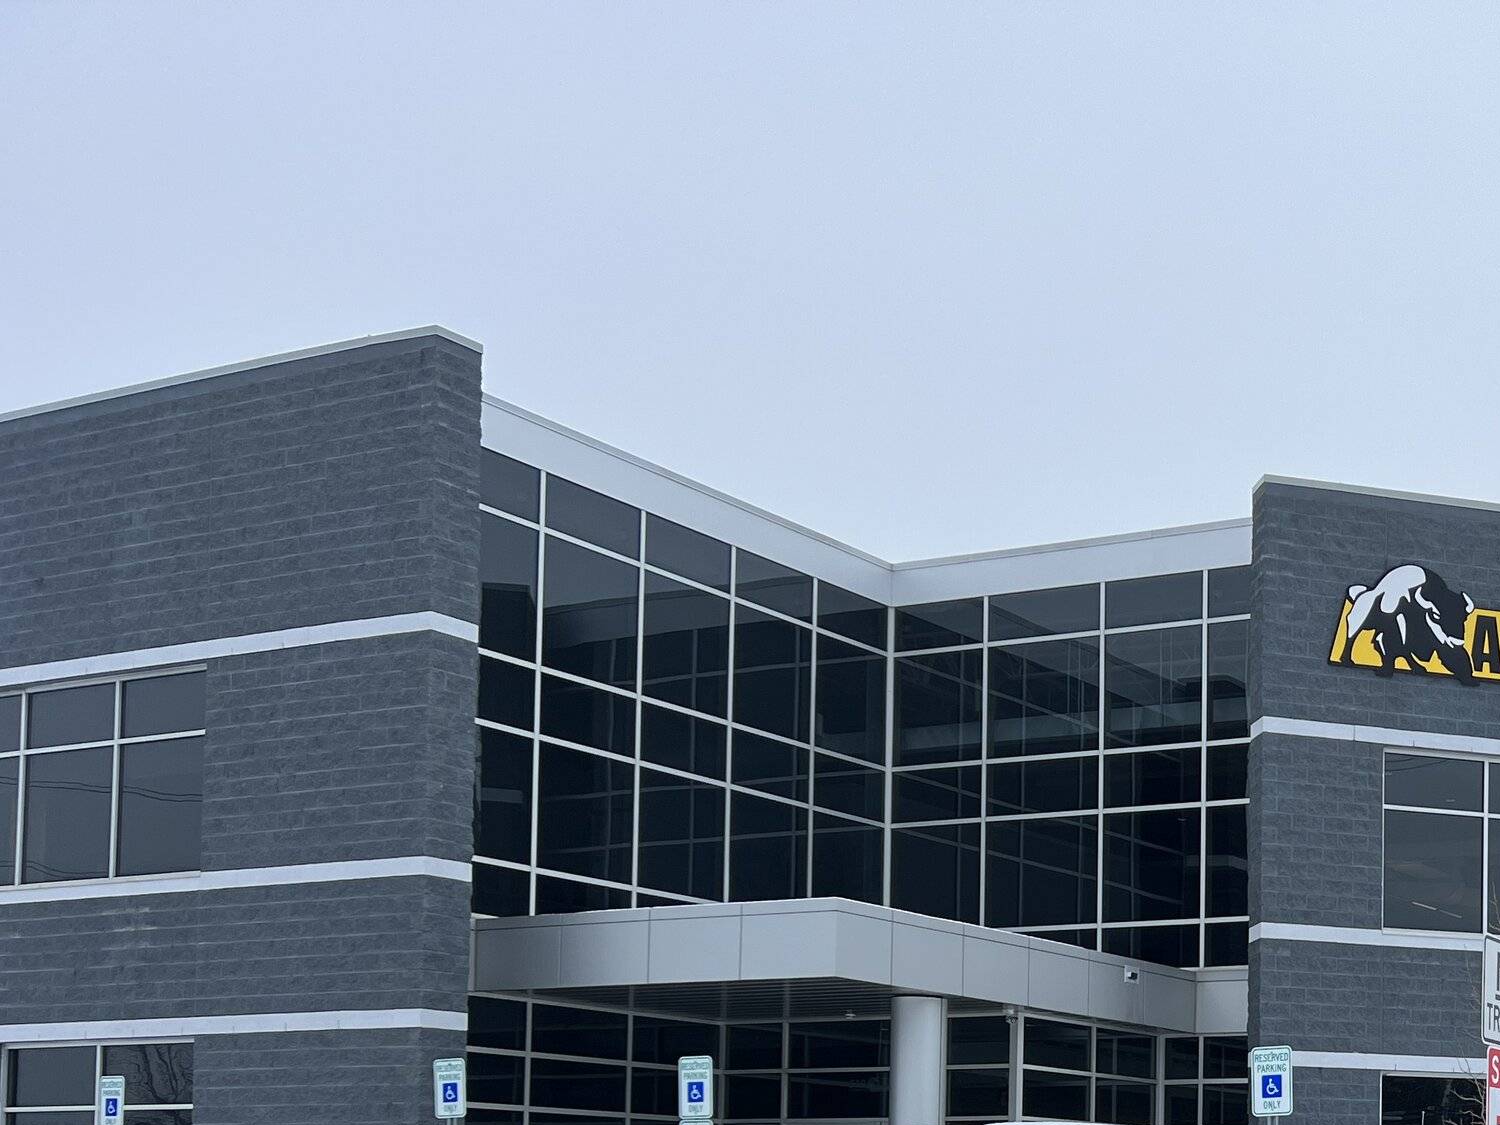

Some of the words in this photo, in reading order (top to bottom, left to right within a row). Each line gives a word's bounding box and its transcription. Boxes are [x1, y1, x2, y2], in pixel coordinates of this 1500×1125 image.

[1254, 1052, 1288, 1062] RESERVED
[1257, 1064, 1287, 1073] PARKING
[1263, 1101, 1281, 1110] ONLY
